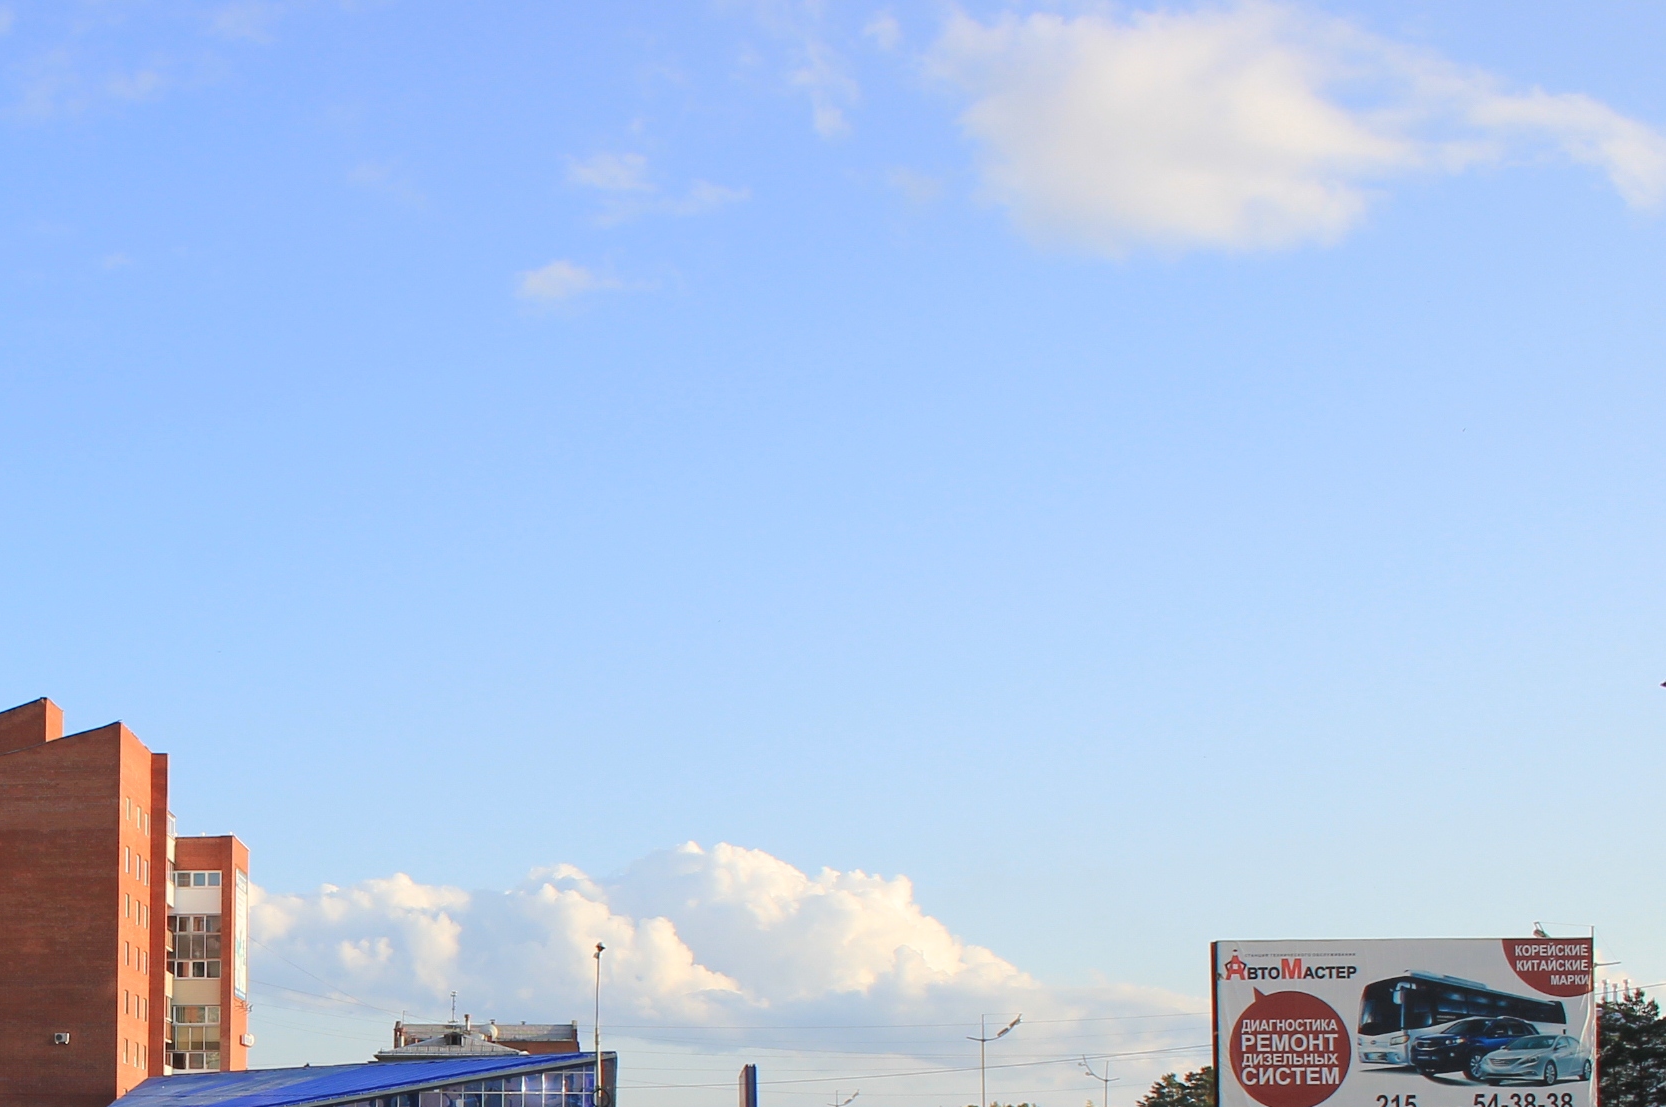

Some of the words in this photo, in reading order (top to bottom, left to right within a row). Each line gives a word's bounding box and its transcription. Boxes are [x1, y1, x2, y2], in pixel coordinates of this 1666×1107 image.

[1515, 942, 1589, 956] КОРЕЙСКИЕ
[1516, 957, 1589, 971] КИТАЙСКИЕ
[1550, 975, 1589, 985] МАРКИ
[1241, 1019, 1338, 1033] ДИАГНОСТИКА
[1241, 1034, 1339, 1052] РЕМОНТ
[1241, 1053, 1339, 1067] ДИЗЕЛЬНЫХ
[1241, 1067, 1340, 1085] СИСТЕМ
